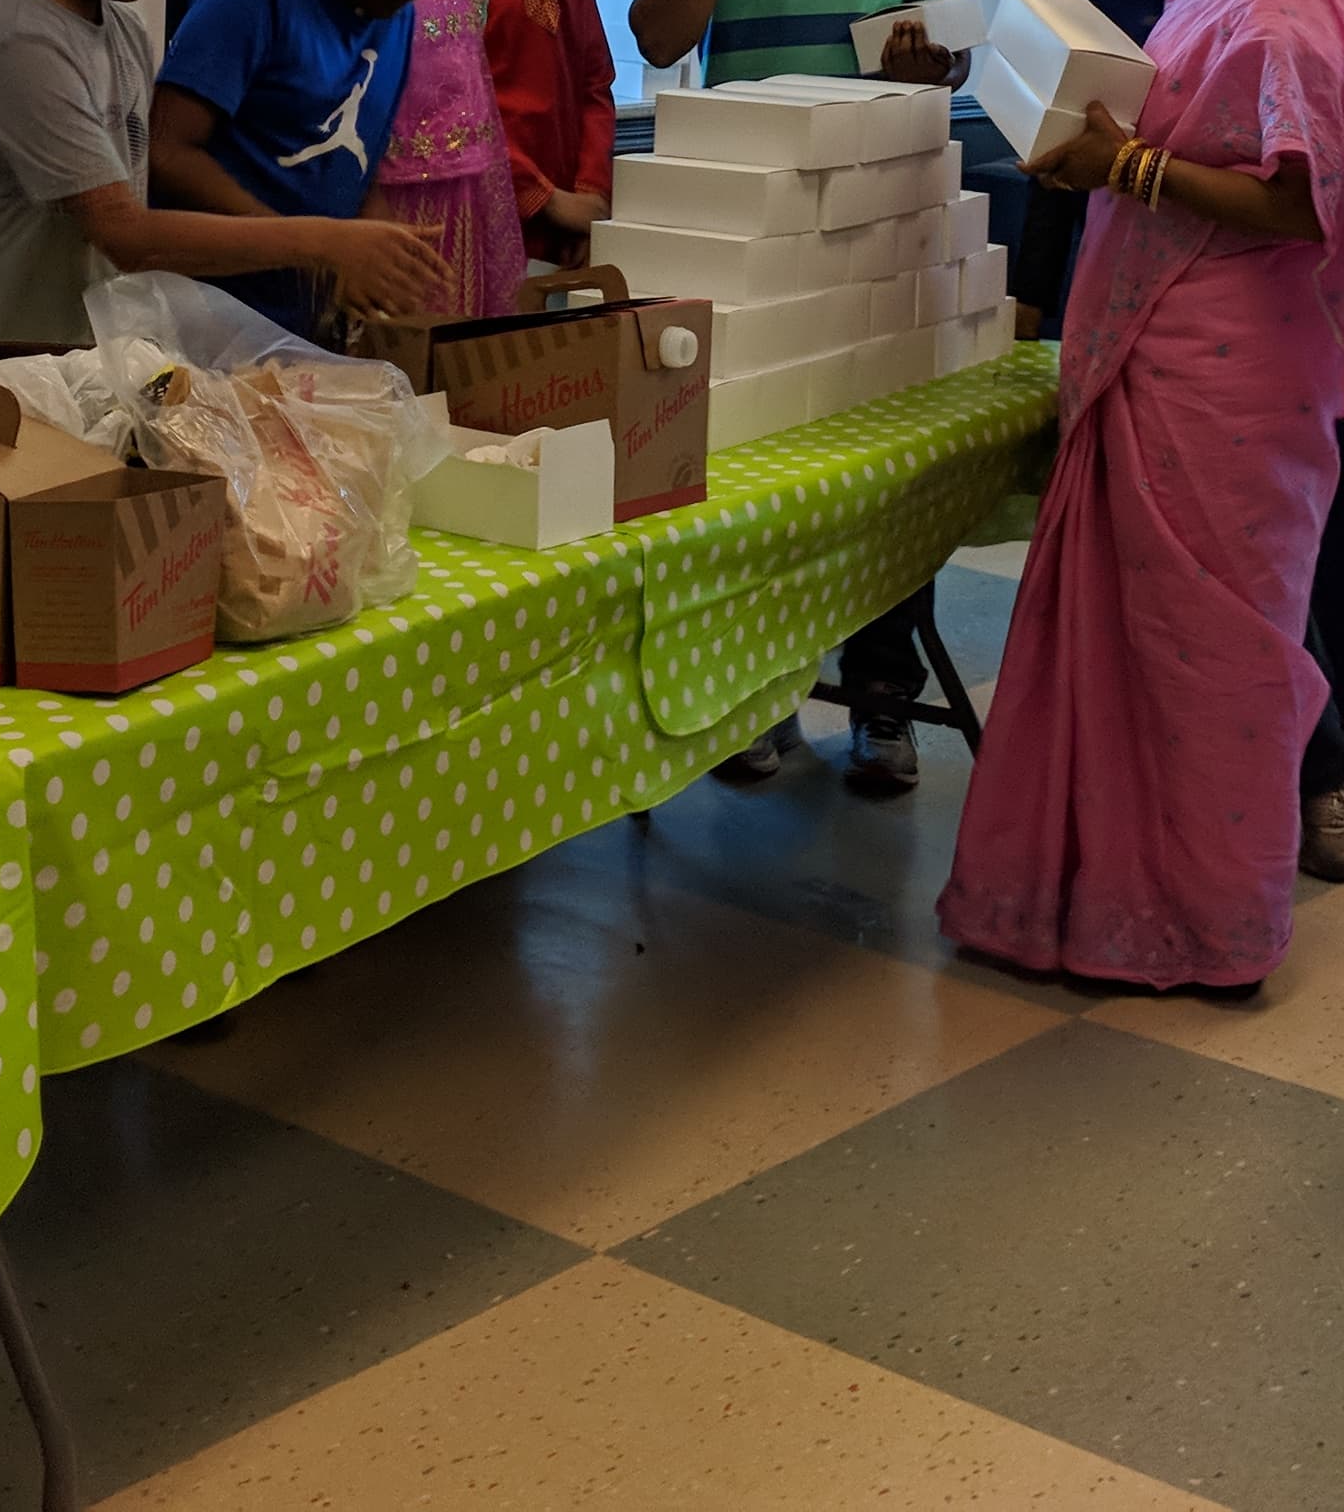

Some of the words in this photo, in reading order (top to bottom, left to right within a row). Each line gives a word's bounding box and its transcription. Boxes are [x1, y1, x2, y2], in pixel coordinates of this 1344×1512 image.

[501, 367, 605, 431] Hortons
[623, 421, 653, 458] Tim
[655, 374, 707, 433] Hortons
[122, 580, 159, 632] Tim
[161, 520, 223, 595] Hortons
